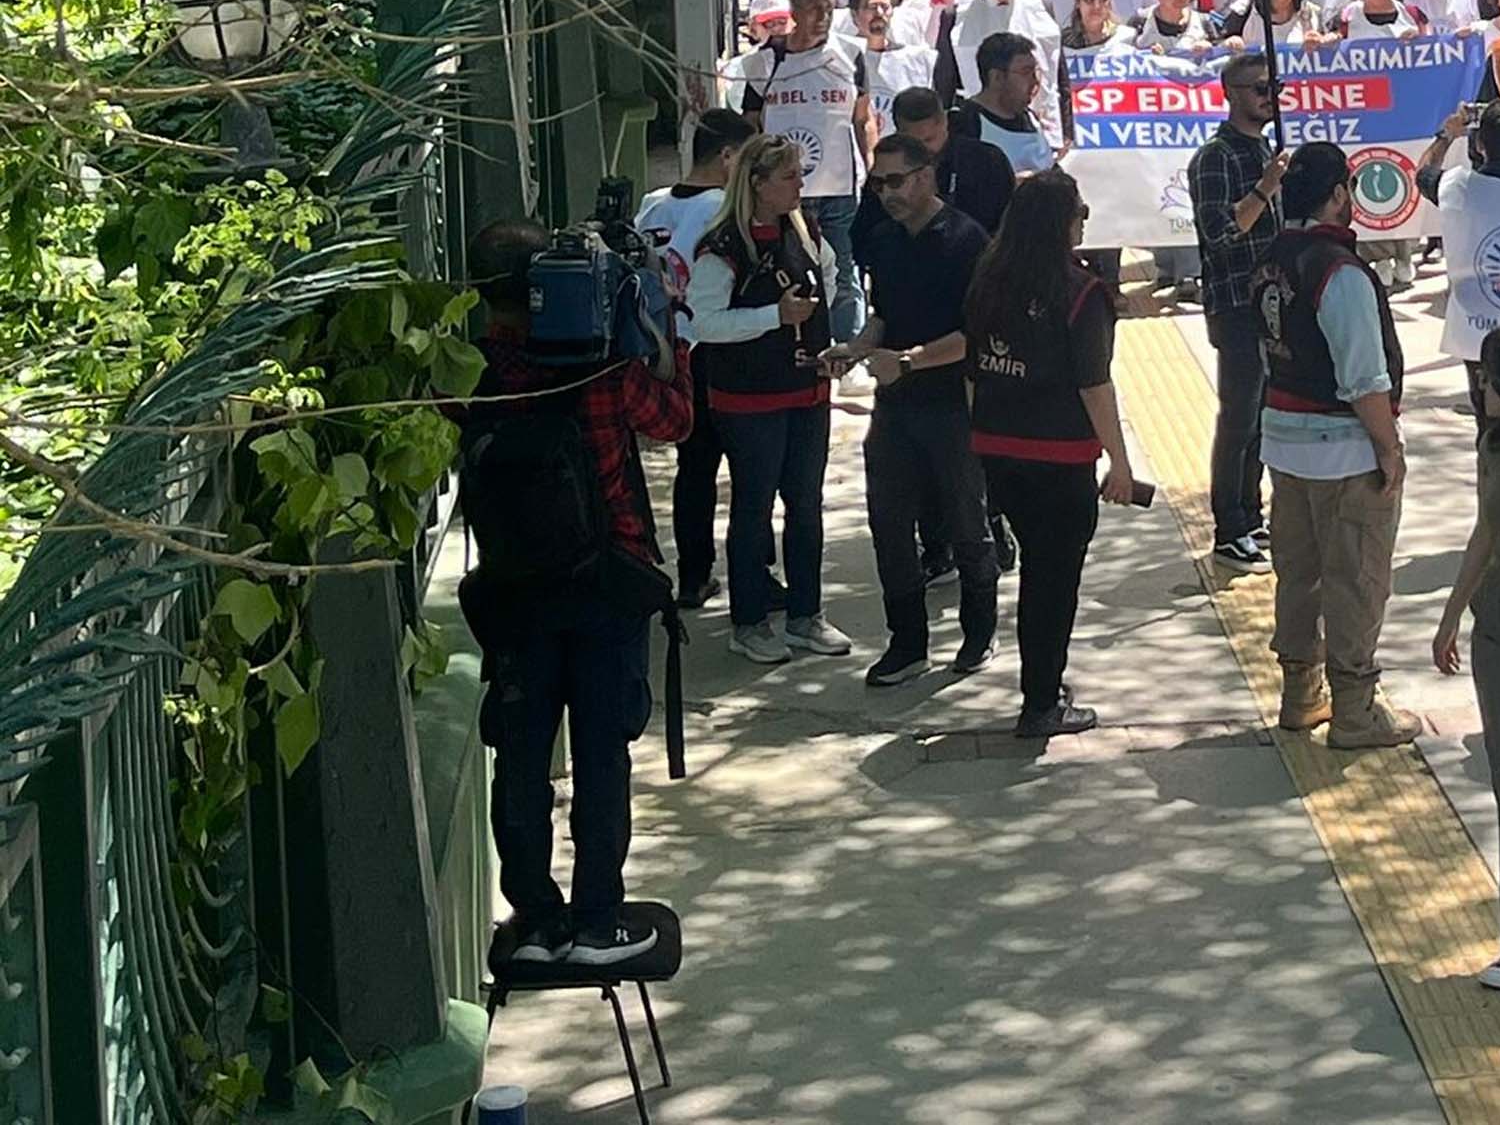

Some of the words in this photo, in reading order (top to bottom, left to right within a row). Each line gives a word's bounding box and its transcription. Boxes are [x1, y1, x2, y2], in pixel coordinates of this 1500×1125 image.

[1277, 40, 1465, 76] IMLARIMIZIN
[821, 89, 847, 103] SEN
[1137, 79, 1366, 115] EDİLSİNE
[979, 353, 1026, 378] ZMİR
